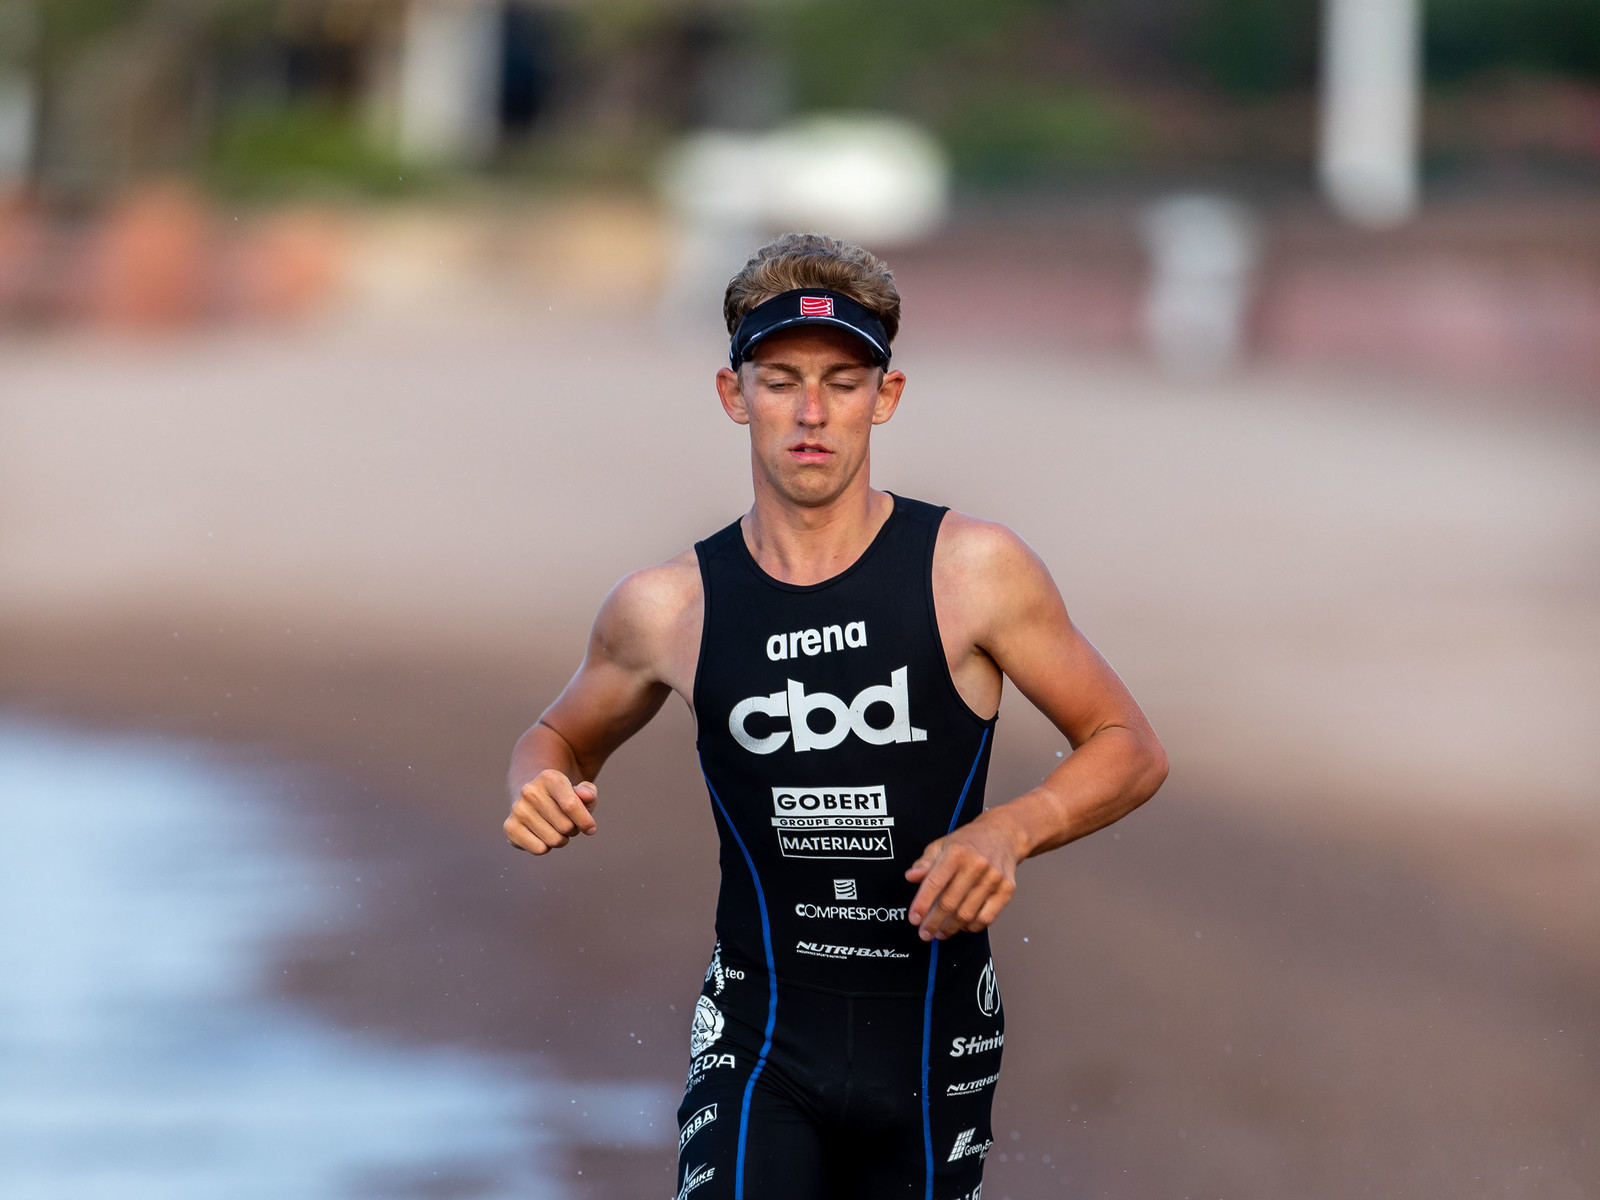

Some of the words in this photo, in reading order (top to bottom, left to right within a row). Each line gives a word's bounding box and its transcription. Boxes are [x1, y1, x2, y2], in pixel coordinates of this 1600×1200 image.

[766, 620, 868, 661] arena
[777, 793, 882, 810] GOBERT
[780, 818, 830, 827] GROUPE
[834, 818, 885, 826] GOBERT
[782, 836, 888, 851] MATERIAUX
[795, 903, 907, 922] COMPRESSPORT
[679, 1109, 715, 1150] TRBA
